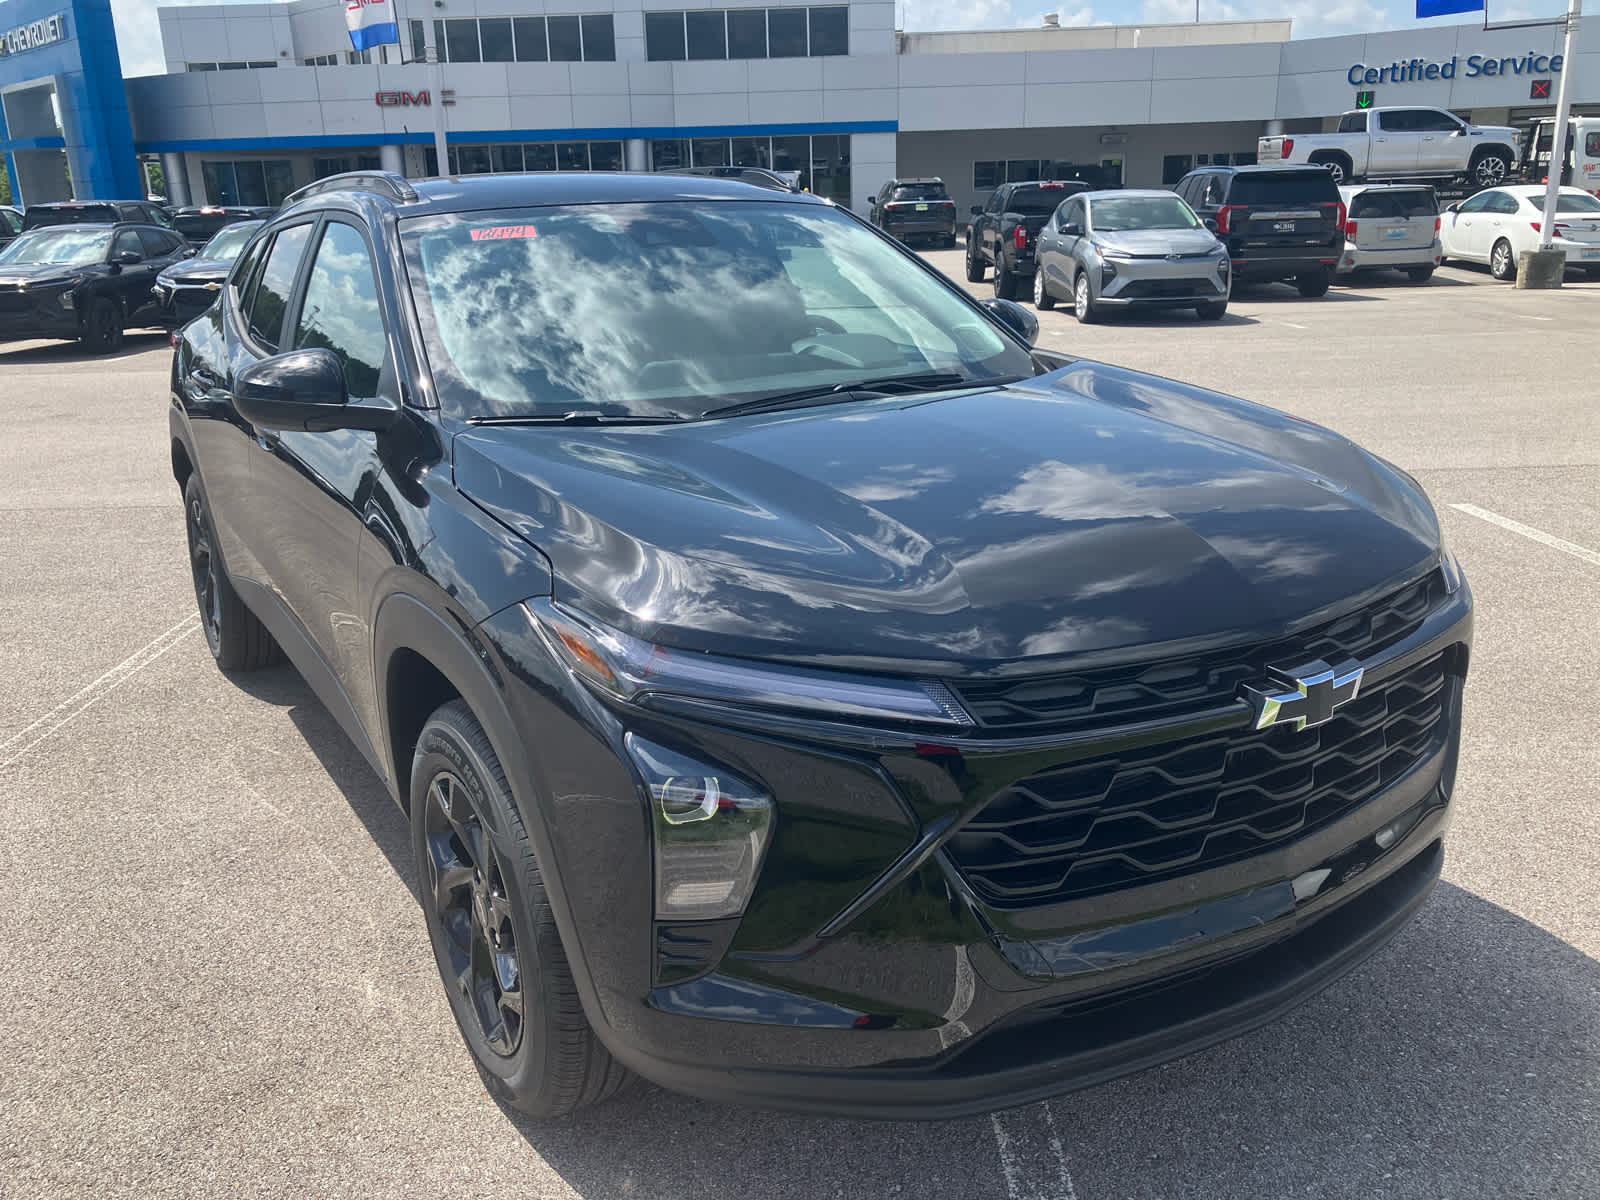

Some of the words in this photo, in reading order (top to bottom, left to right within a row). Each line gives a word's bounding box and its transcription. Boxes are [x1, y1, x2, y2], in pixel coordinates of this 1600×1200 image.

[7, 14, 64, 54] CHEVROLET
[1347, 56, 1457, 86] Certified
[1465, 51, 1564, 78] Service
